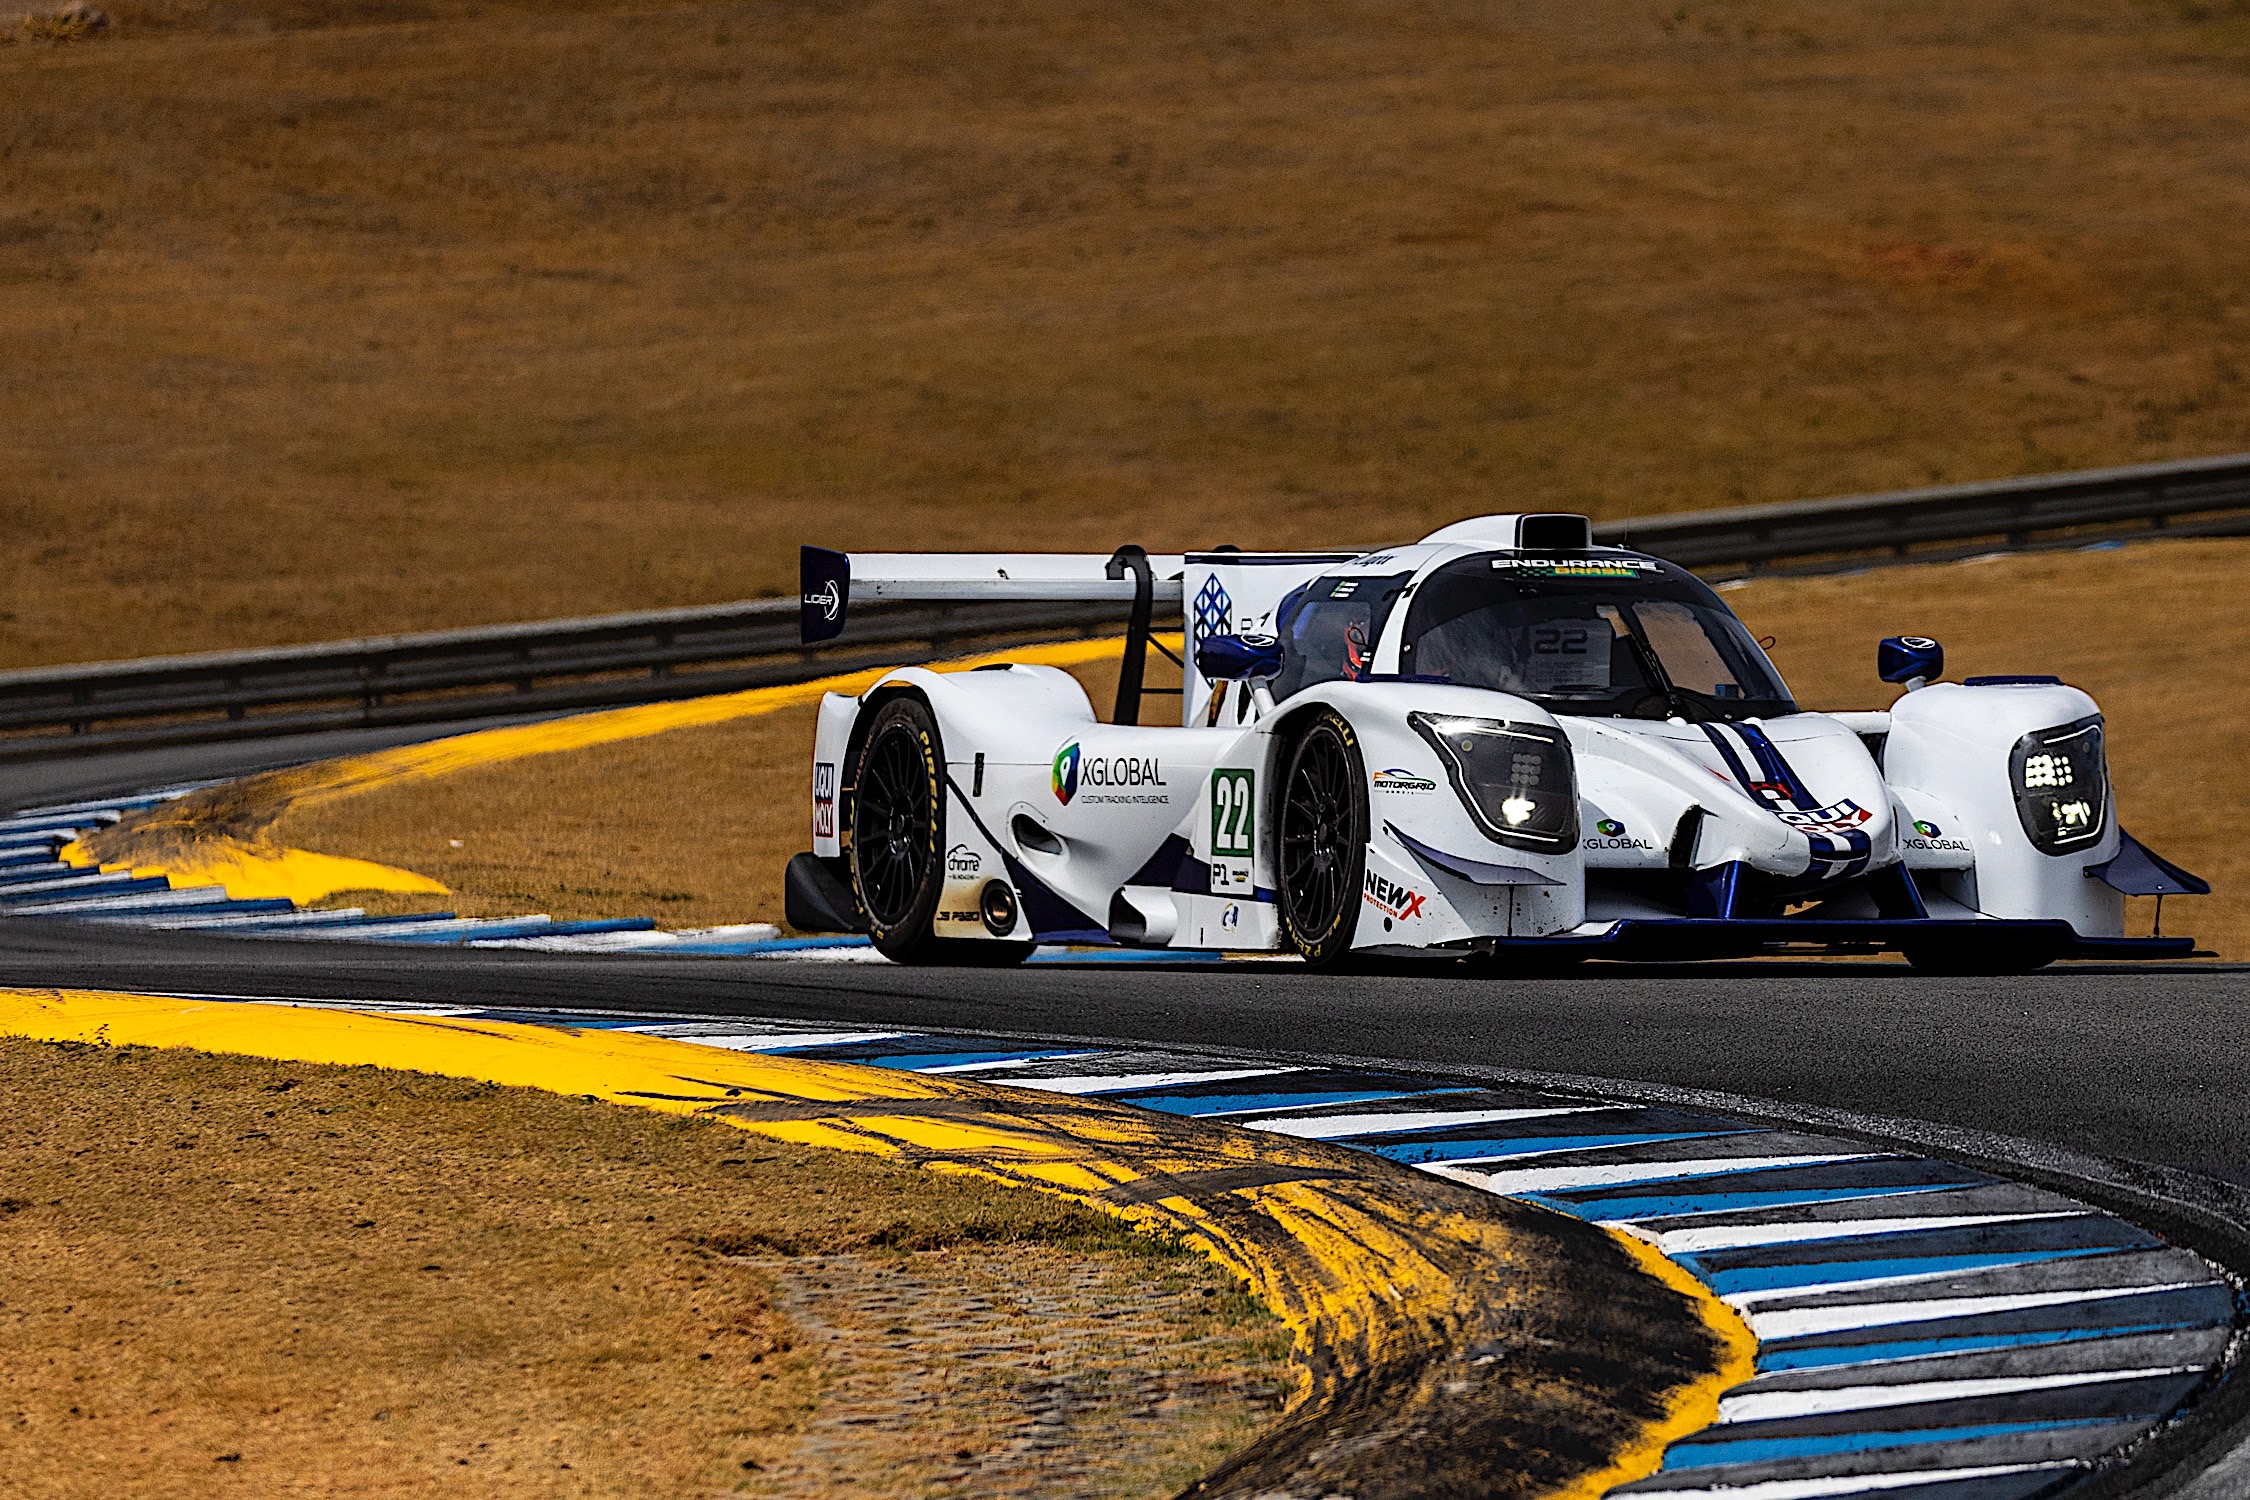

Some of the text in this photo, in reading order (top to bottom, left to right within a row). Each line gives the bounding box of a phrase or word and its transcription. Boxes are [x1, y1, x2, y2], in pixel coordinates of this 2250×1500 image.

[1491, 559, 1656, 570] ENDURANCE
[1555, 567, 1632, 576] BRASIL
[1535, 630, 1587, 654] 22
[815, 766, 833, 798] LIQUI
[1080, 757, 1167, 786] XGLOBAL
[815, 803, 833, 834] MOLY
[1216, 776, 1249, 850] 22
[1902, 838, 1970, 851] XGLOBAL
[1213, 863, 1230, 886] P1
